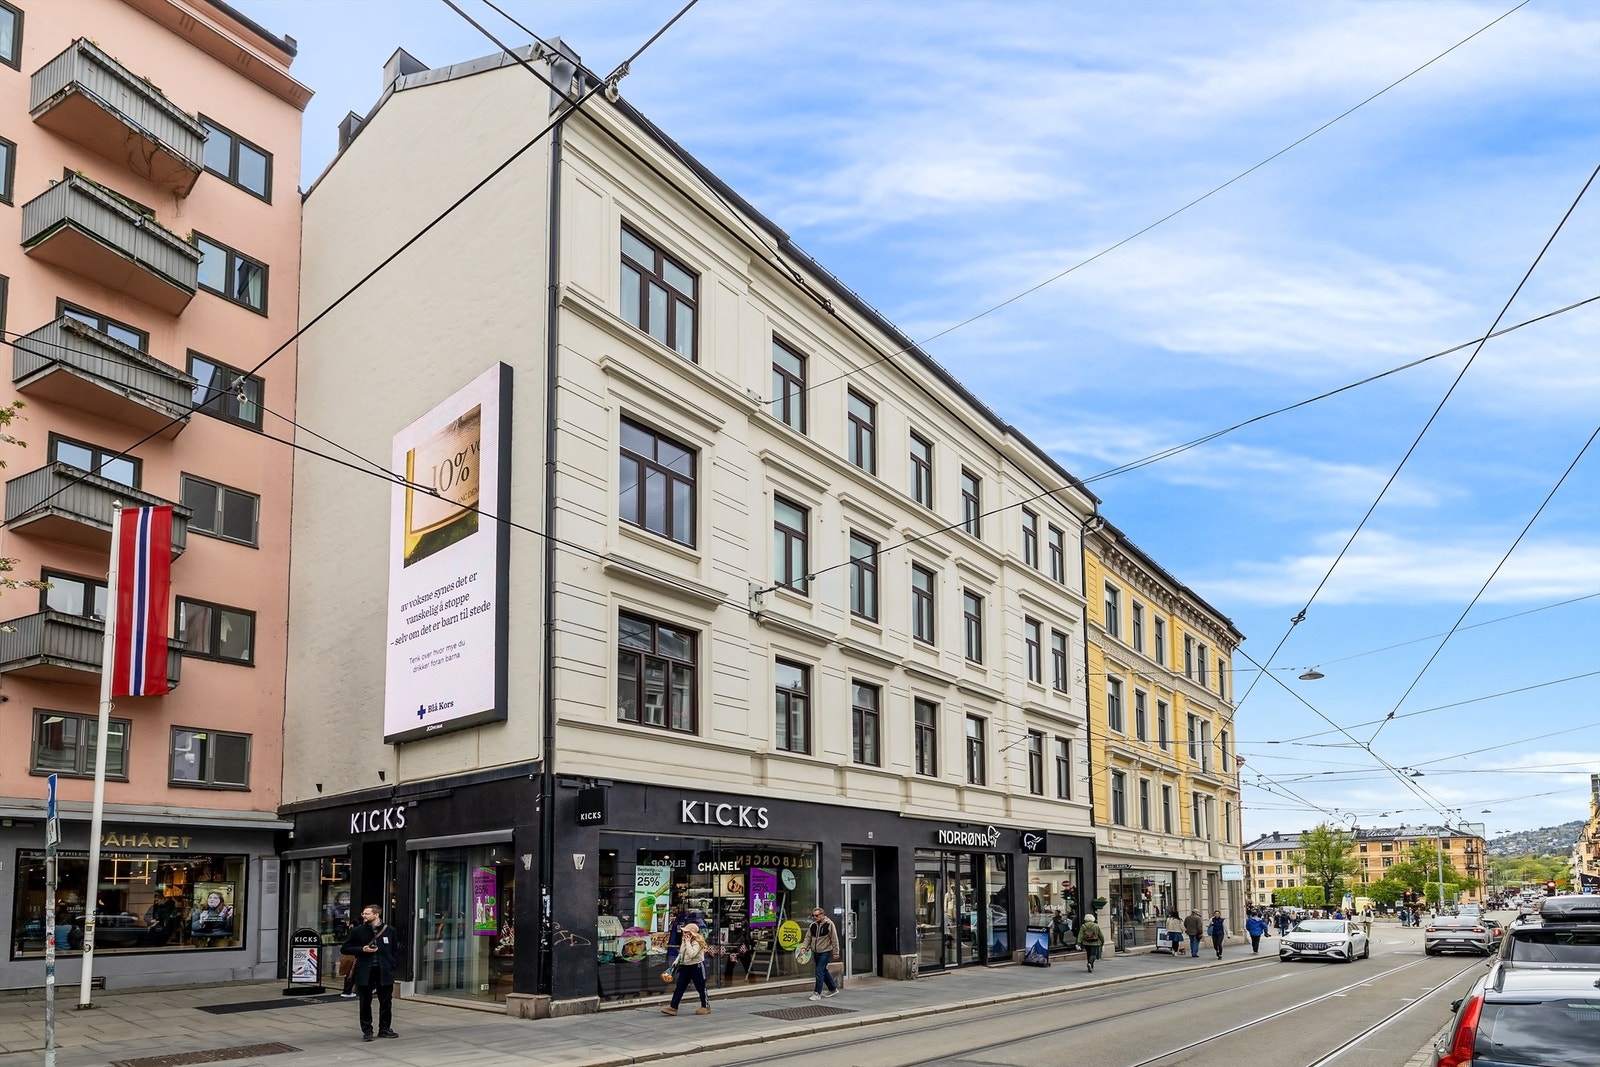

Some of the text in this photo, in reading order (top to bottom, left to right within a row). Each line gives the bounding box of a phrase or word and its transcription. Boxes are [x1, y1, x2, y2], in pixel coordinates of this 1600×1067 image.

[432, 447, 469, 491] 10%
[400, 572, 478, 612] av voksne synes det er
[406, 592, 470, 625] vanskelig å stoppe
[408, 628, 420, 639] om
[420, 624, 432, 635] det
[432, 621, 440, 631] er
[441, 614, 459, 628] barn
[459, 607, 468, 620] til
[469, 600, 491, 616] stede
[421, 651, 432, 660] over
[433, 646, 445, 655] hvor
[445, 642, 457, 652] mye
[458, 639, 466, 648] du
[412, 652, 461, 673] drikker foran barna
[427, 700, 454, 713] Blå Kors
[350, 805, 406, 834] KICKS
[580, 811, 602, 821] KICKS
[682, 800, 769, 829] KICKS
[939, 830, 988, 847] NORRØNA
[697, 861, 741, 872] CHANEL
[475, 885, 488, 895] 25%
[637, 876, 660, 887] 25%
[752, 883, 768, 892] 25%
[783, 933, 798, 943] 25%
